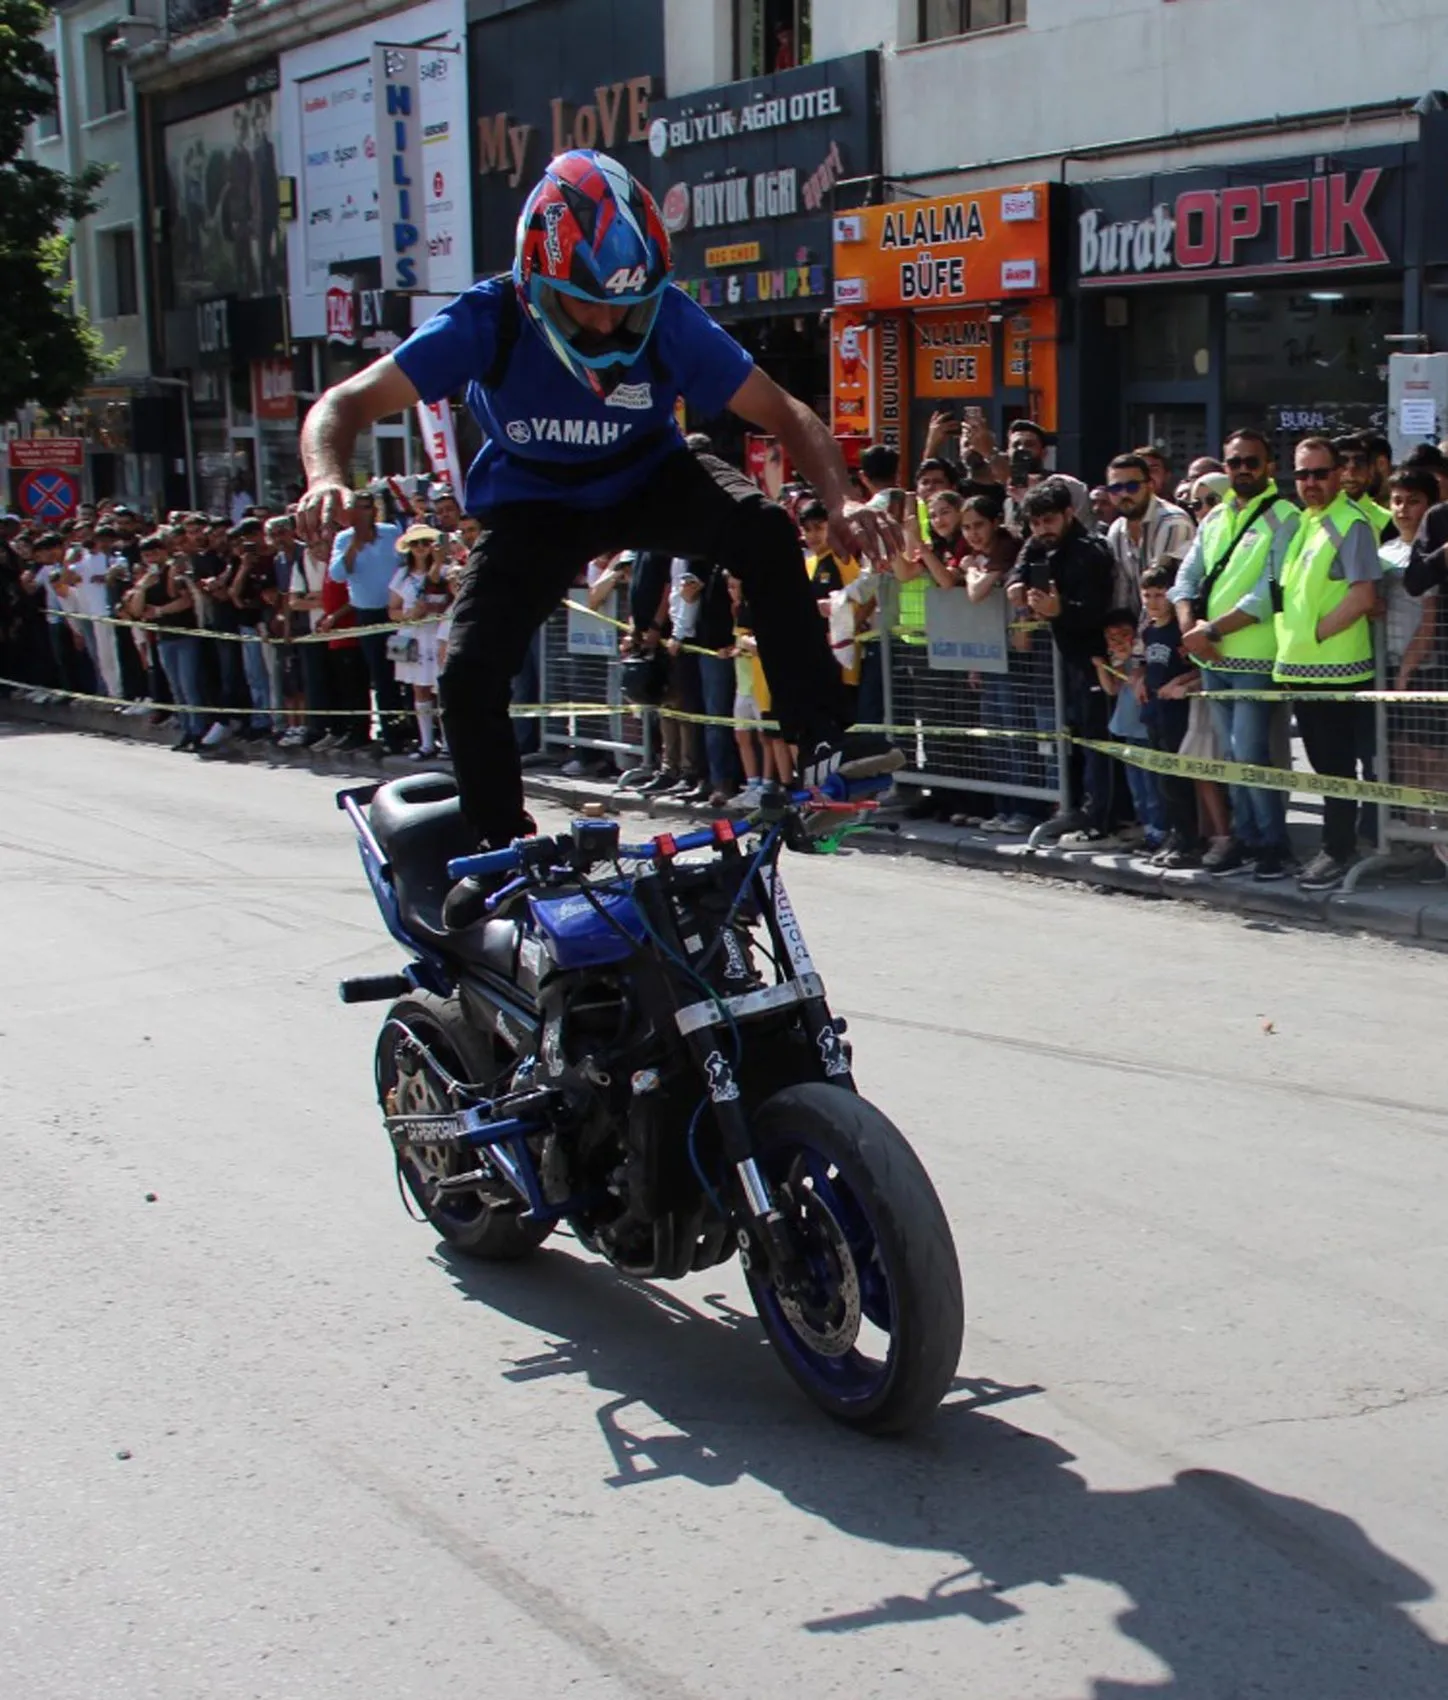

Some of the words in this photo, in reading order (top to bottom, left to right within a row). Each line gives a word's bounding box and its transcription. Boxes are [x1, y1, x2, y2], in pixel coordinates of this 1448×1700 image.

[668, 103, 734, 148] BÜYÜK
[739, 93, 787, 133] AĞRI
[789, 87, 842, 122] OTEL
[478, 112, 532, 188] My
[692, 166, 749, 228] BÜYÜK
[880, 200, 985, 250] ALALMA
[1079, 202, 1176, 274] Burak
[605, 264, 648, 294] 44
[900, 251, 965, 300] BÜFE
[920, 320, 992, 348] ALALMA
[882, 318, 900, 420] BULUNUR
